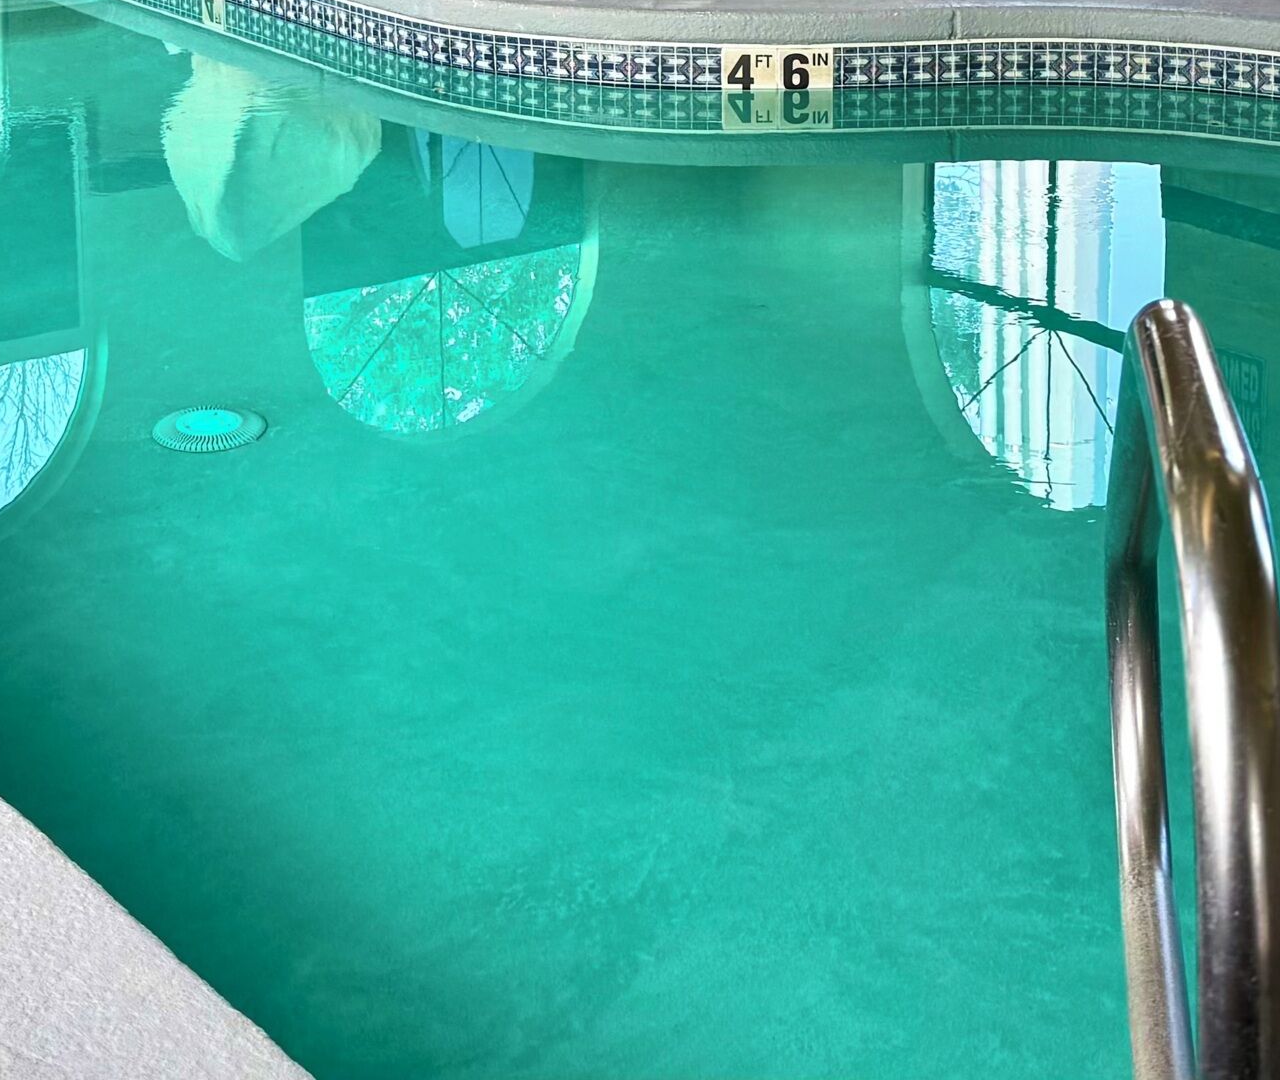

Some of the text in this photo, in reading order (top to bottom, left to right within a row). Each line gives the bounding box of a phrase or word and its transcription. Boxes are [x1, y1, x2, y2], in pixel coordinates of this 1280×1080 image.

[727, 53, 828, 90] 4 FT 6 IN
